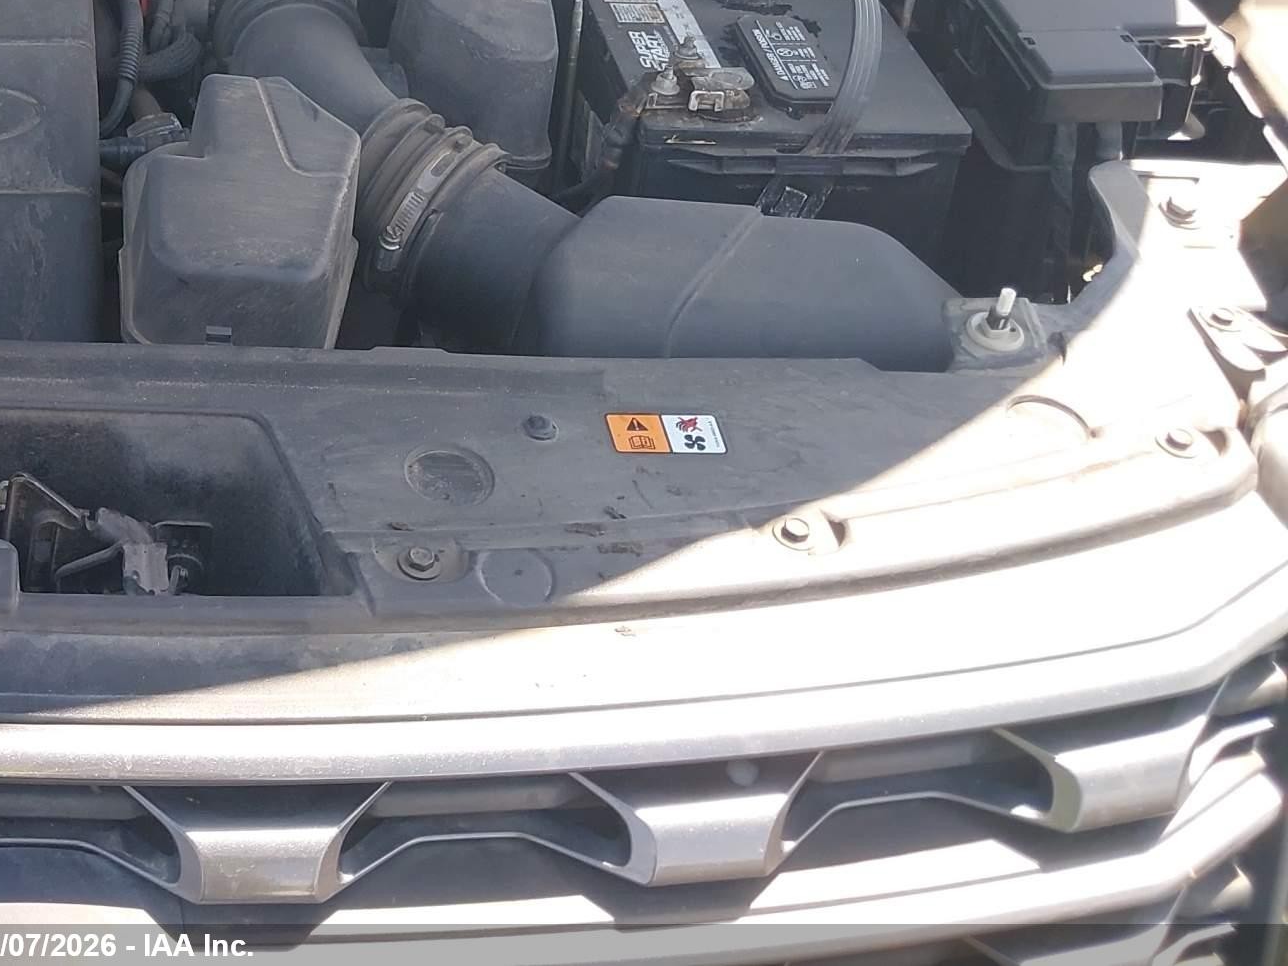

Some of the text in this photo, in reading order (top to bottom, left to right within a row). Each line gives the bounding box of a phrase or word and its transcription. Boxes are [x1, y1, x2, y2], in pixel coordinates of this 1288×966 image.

[628, 31, 656, 69] SUPER
[641, 31, 669, 71] START
[752, 29, 770, 48] POISON
[766, 52, 786, 75] DANGER
